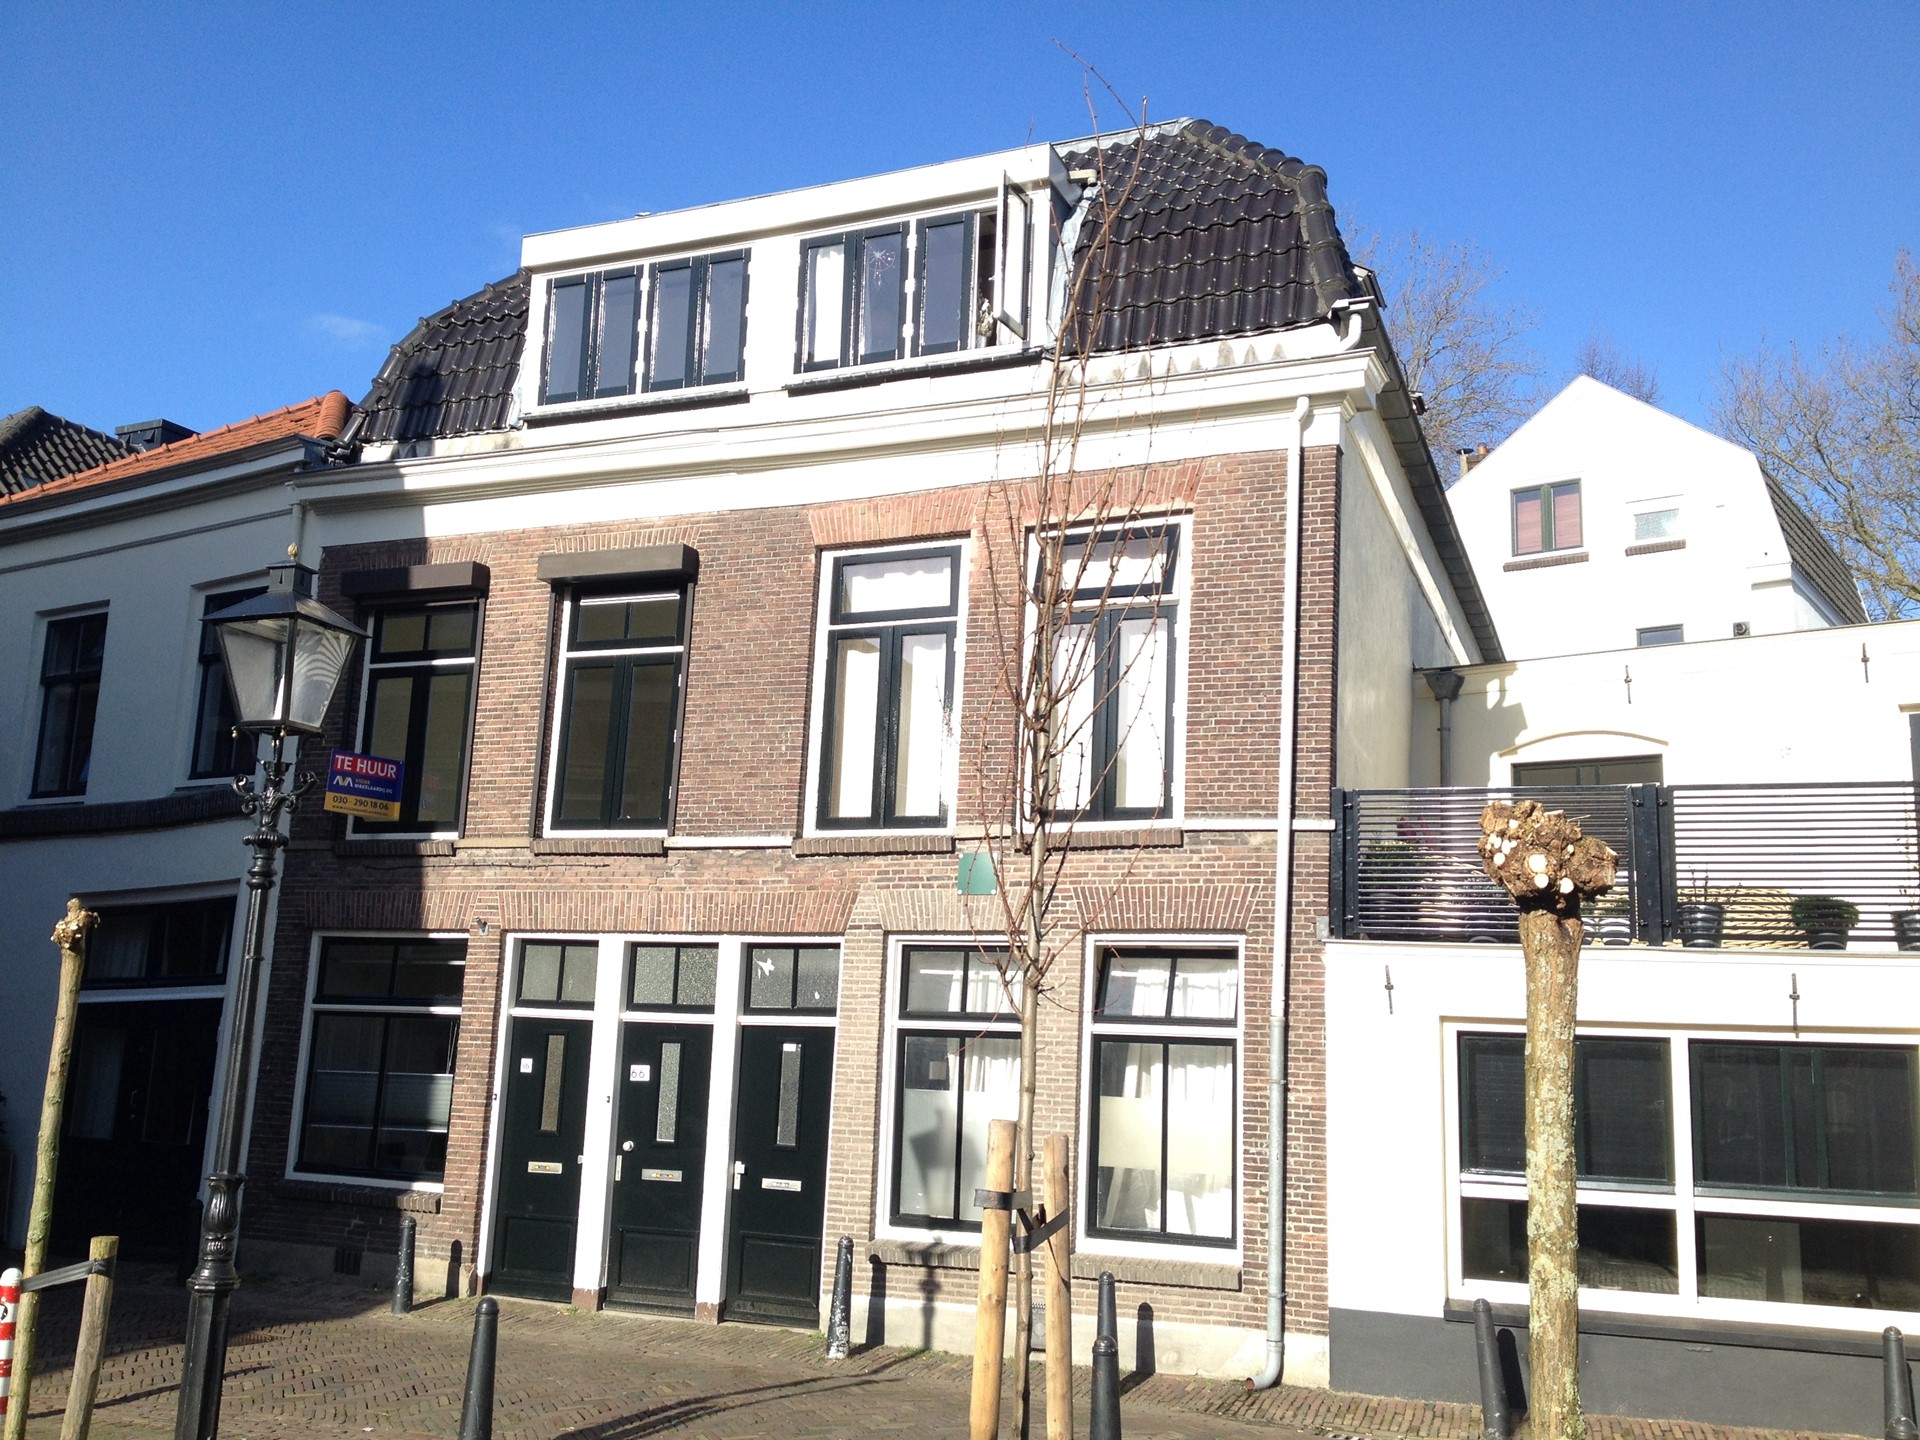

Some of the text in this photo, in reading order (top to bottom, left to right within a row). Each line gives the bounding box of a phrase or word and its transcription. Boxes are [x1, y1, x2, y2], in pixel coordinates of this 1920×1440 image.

[335, 754, 396, 779] TE HUUR
[332, 795, 348, 804] 030
[353, 798, 368, 808] 290
[370, 800, 378, 808] 18
[379, 802, 389, 810] 06
[631, 1067, 645, 1079] 66
